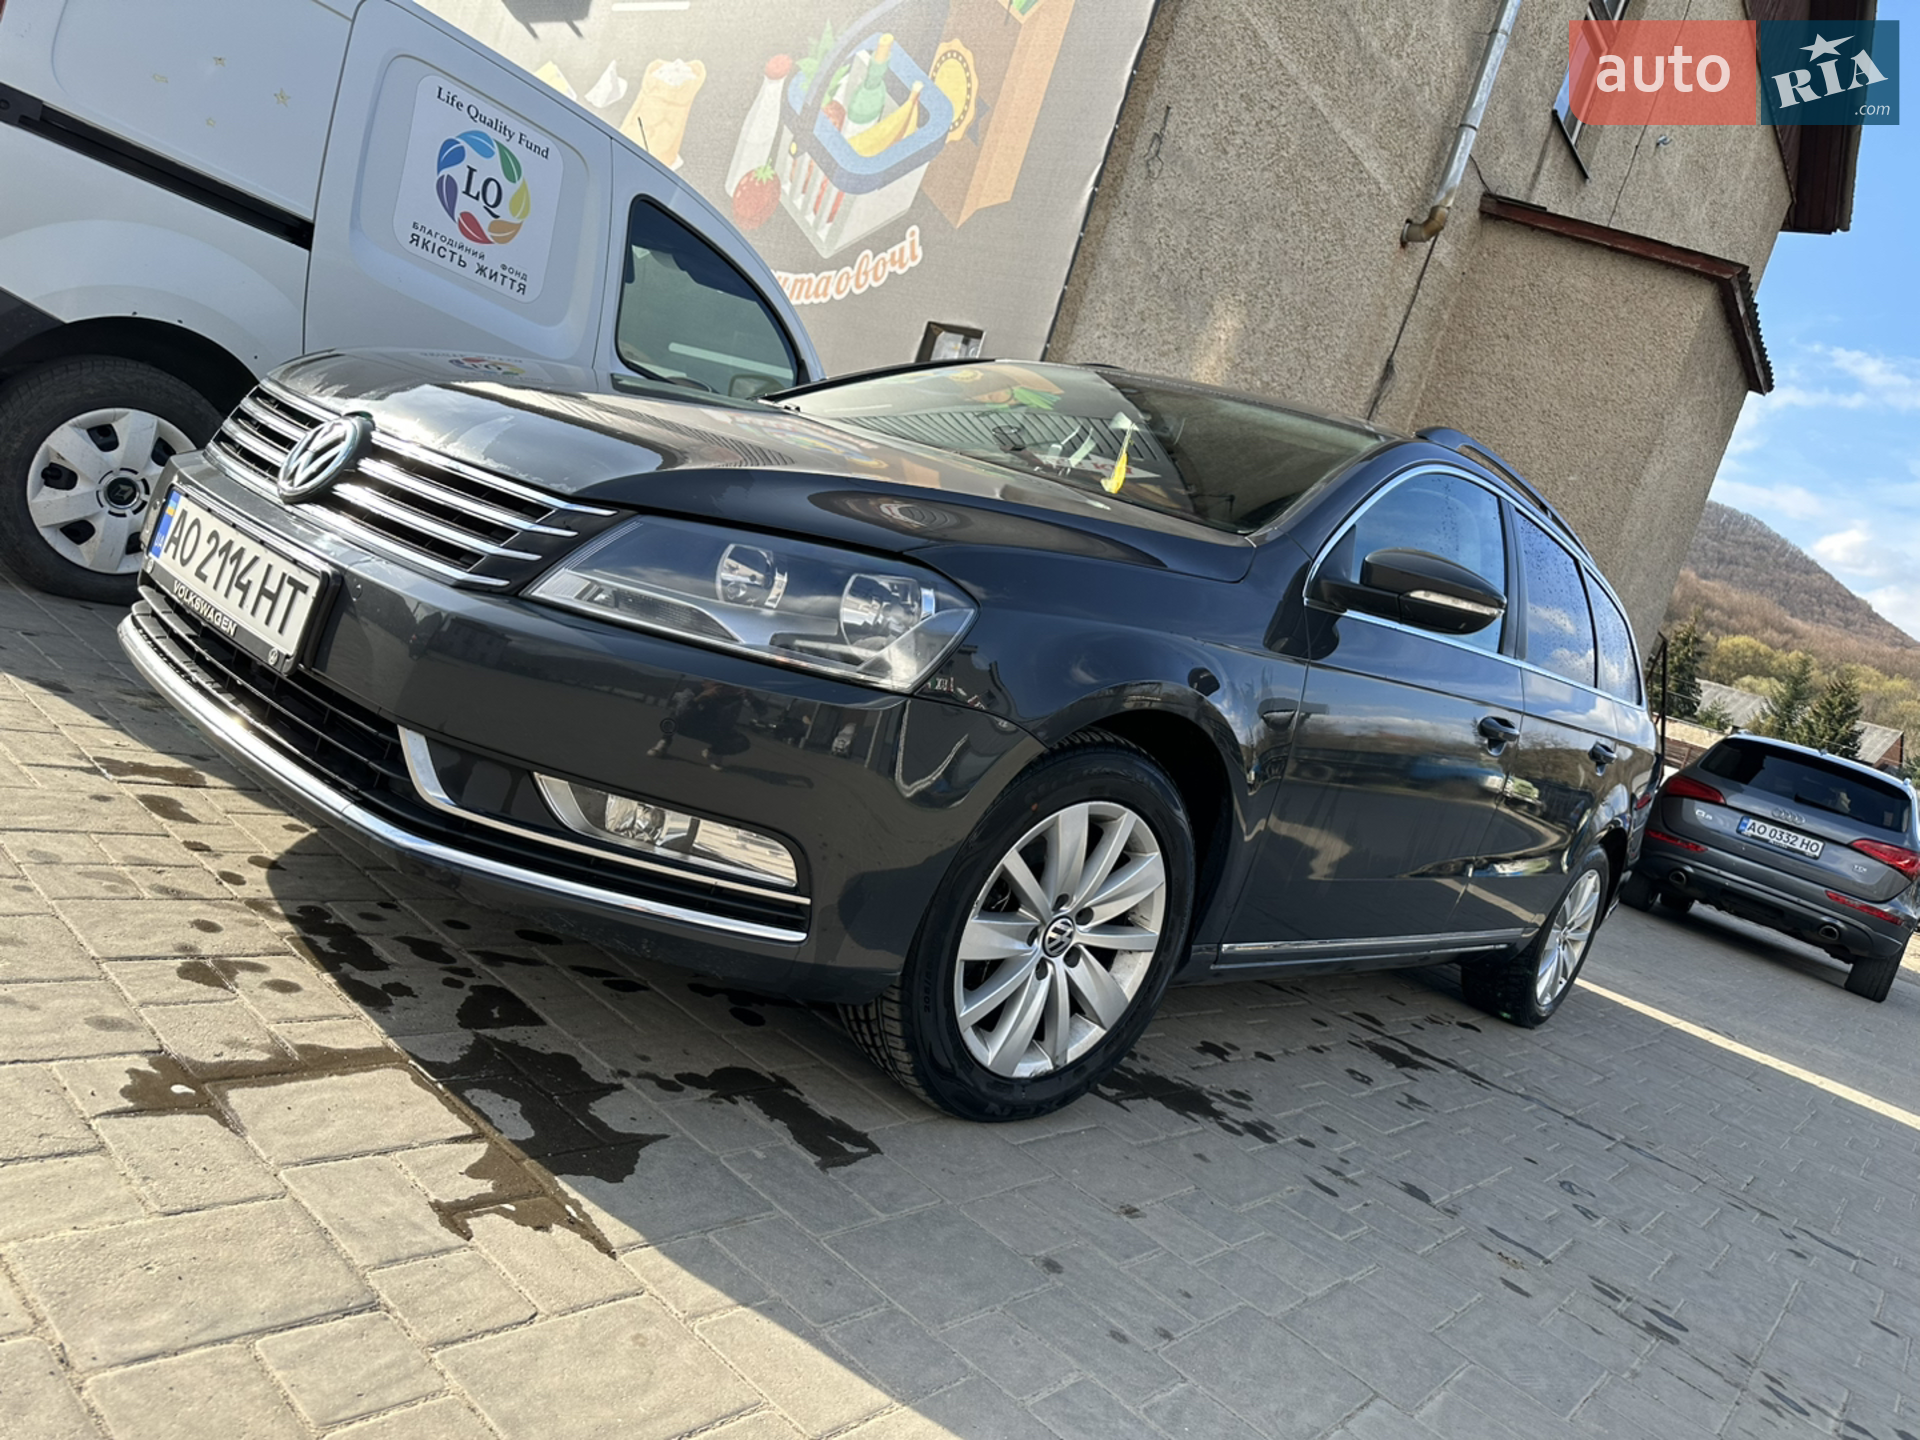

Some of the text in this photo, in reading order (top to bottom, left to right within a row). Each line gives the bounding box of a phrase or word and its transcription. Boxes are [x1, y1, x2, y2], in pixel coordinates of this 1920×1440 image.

[436, 85, 550, 160] Life Quality Fund
[461, 164, 504, 219] LQ
[409, 232, 528, 296] ЯКІСТЬ ЖИТТЯ
[412, 221, 529, 282] БЛАГОДІЙНИЙ ФОНД
[171, 579, 238, 637] VOLKSWAGEN
